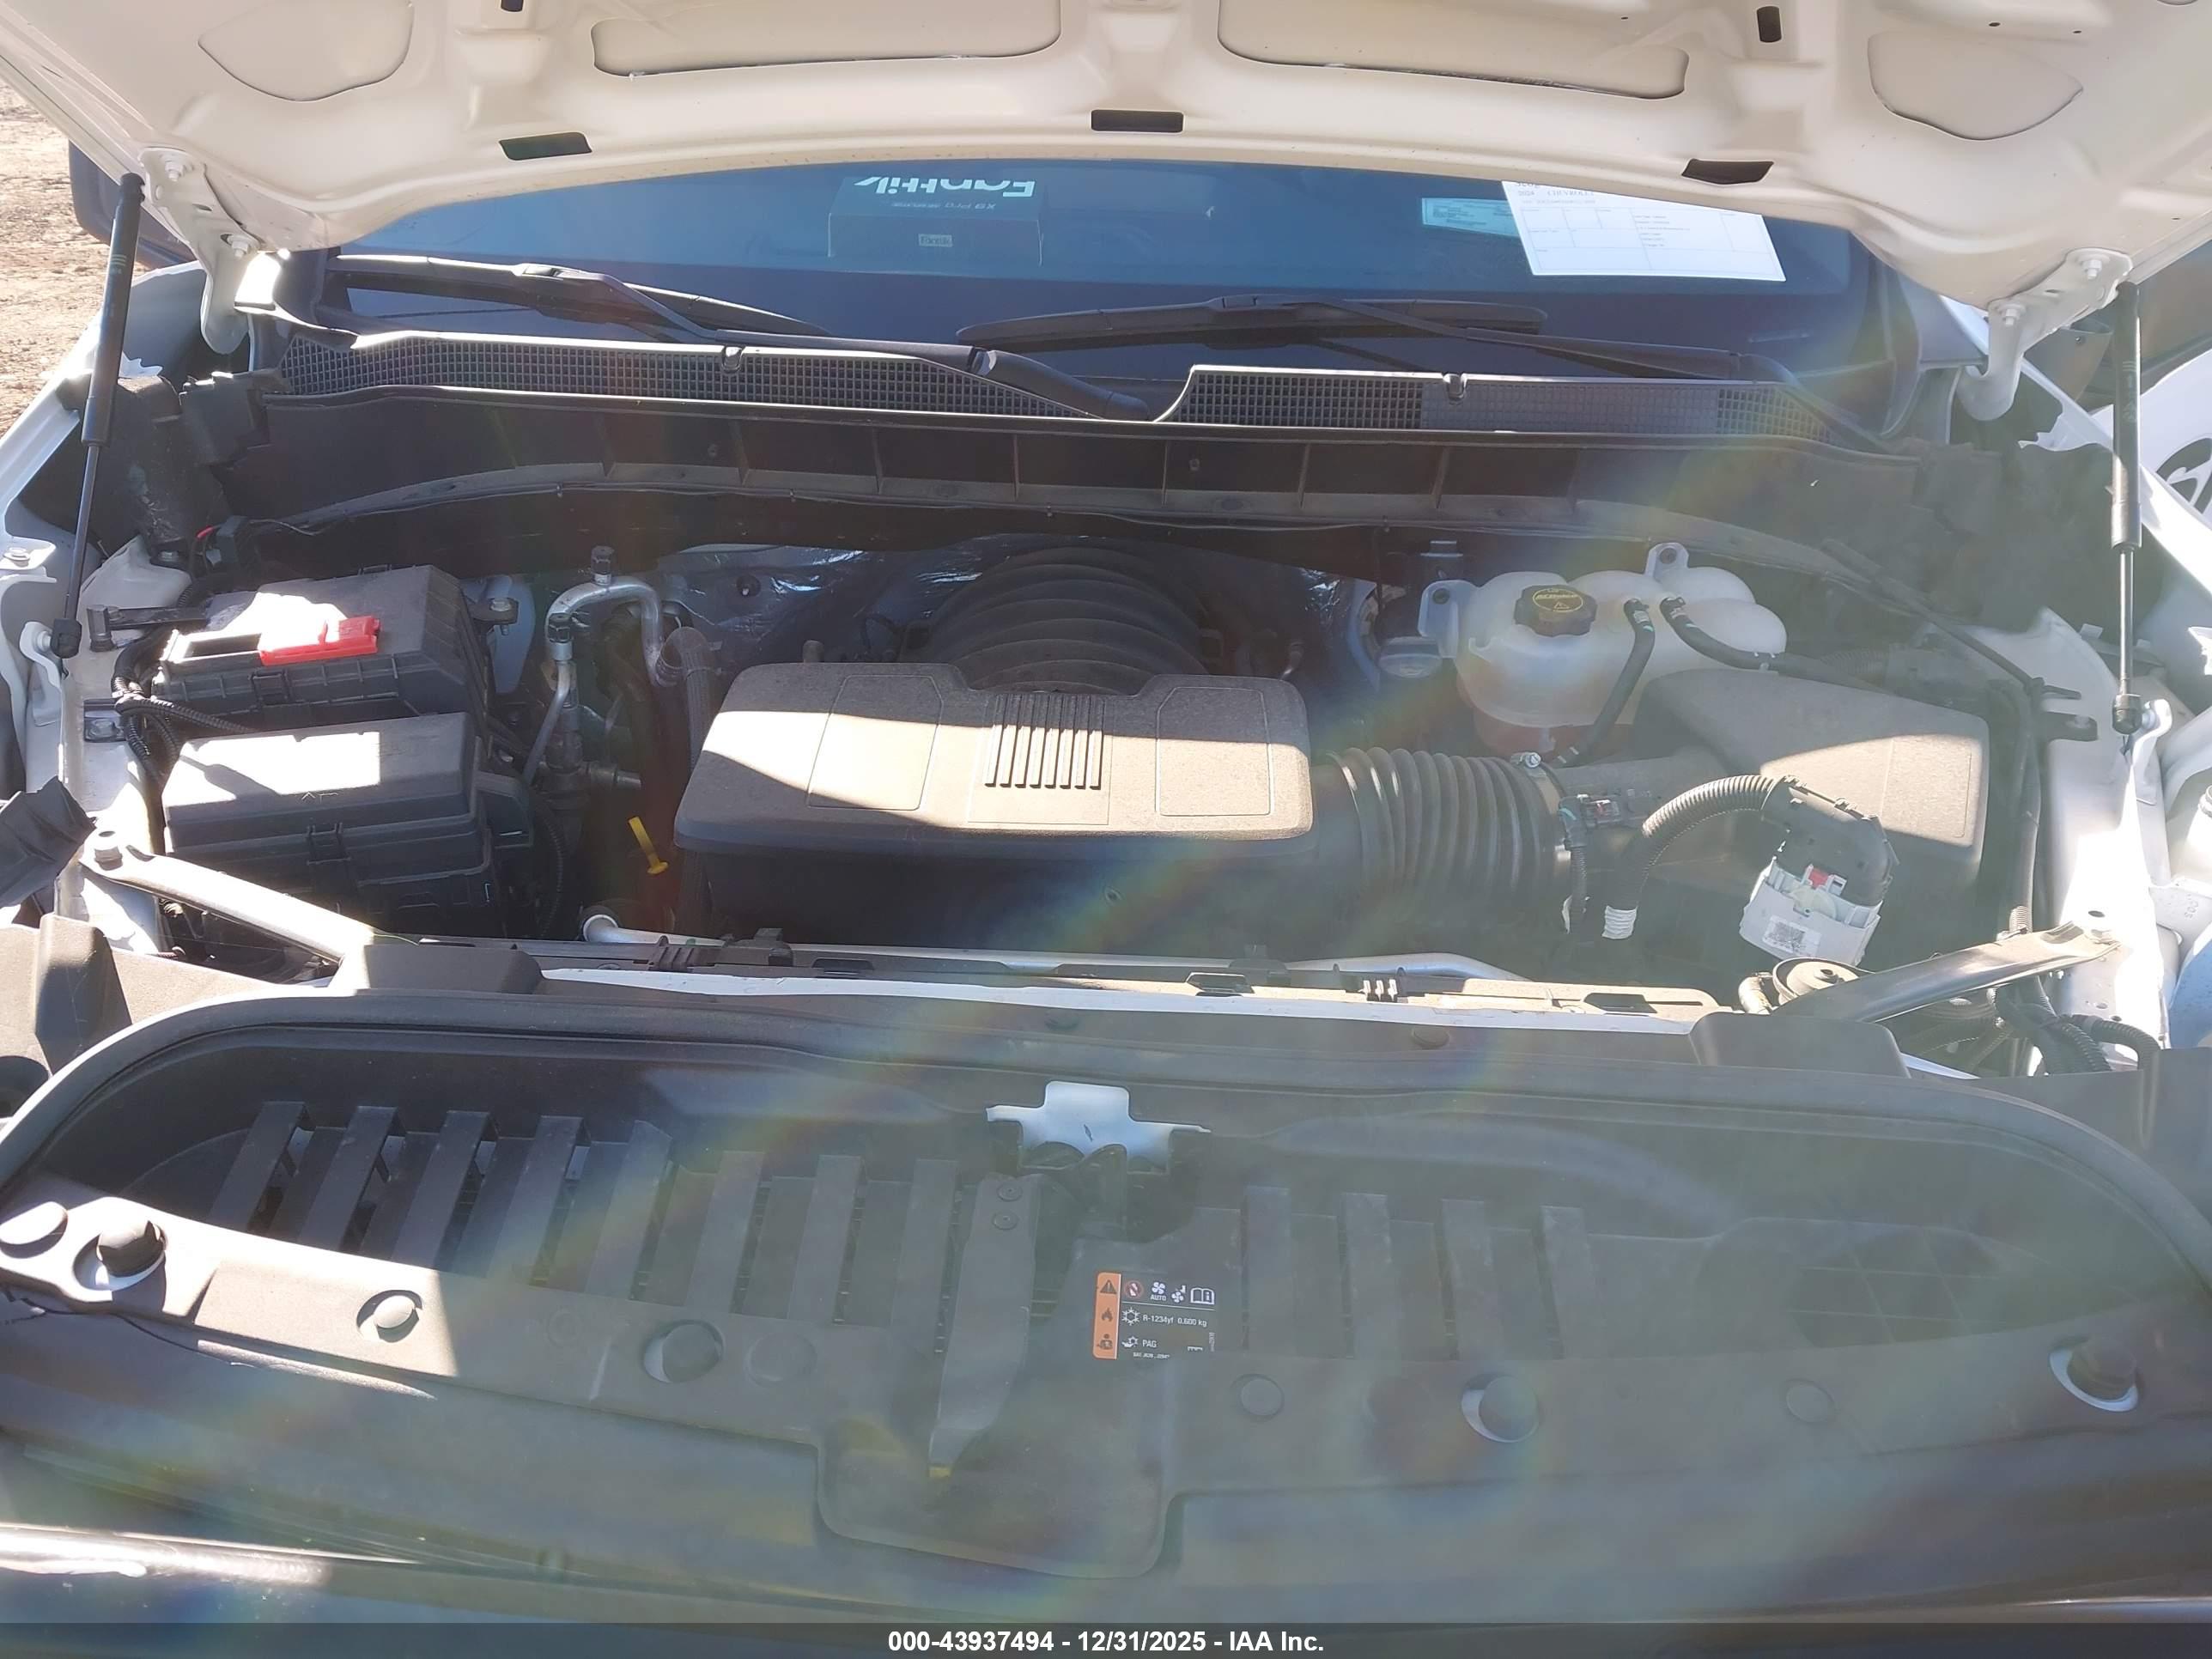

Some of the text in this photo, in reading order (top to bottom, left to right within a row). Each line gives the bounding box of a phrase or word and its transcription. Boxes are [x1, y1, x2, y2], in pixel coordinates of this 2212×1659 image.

[1142, 1314, 1174, 1324] R-1234yf
[1198, 1319, 1207, 1328] kg
[1142, 1339, 1157, 1348] PAG
